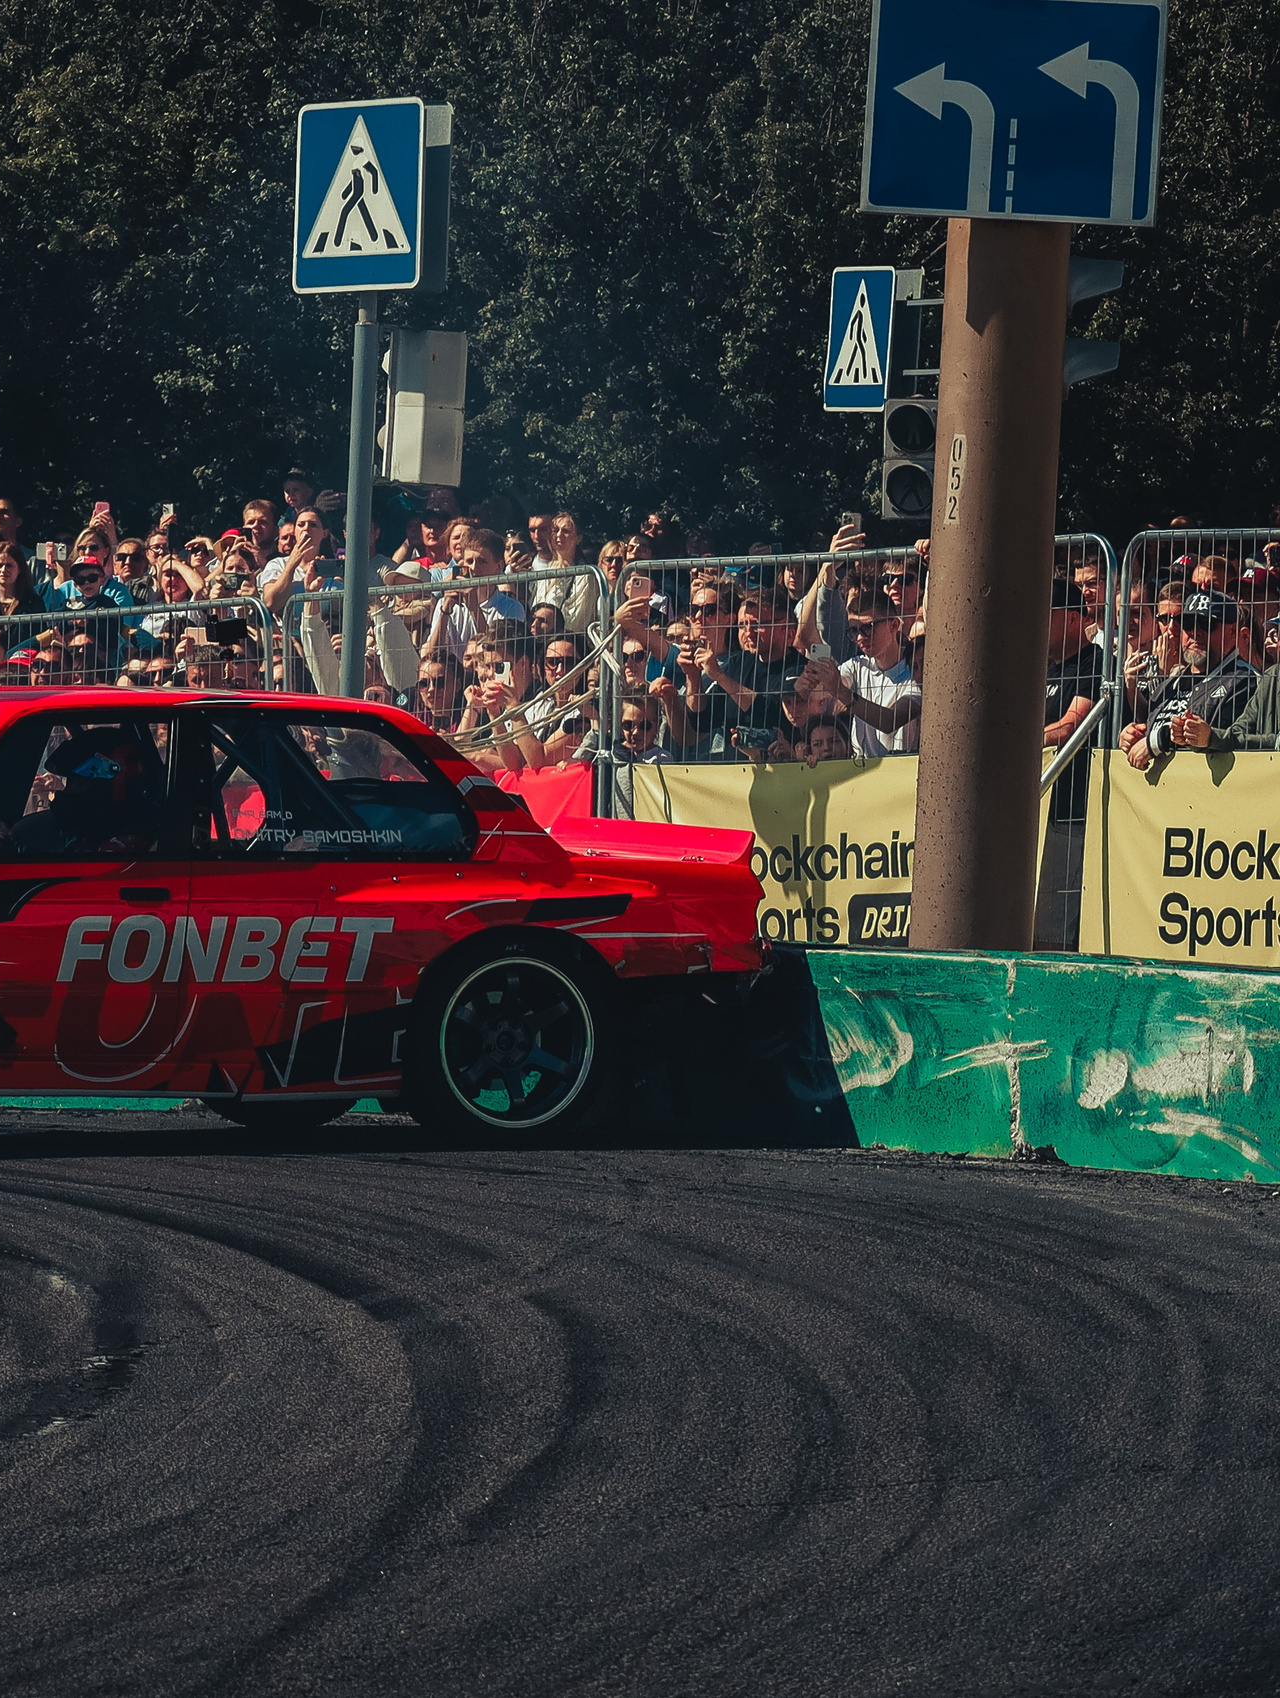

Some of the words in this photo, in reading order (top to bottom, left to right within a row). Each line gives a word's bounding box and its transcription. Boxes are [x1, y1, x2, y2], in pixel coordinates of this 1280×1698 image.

[948, 438, 962, 520] 052
[302, 828, 402, 843] SAMOSHKIN
[56, 914, 395, 983] FONBET
[1158, 891, 1280, 957] Sport
